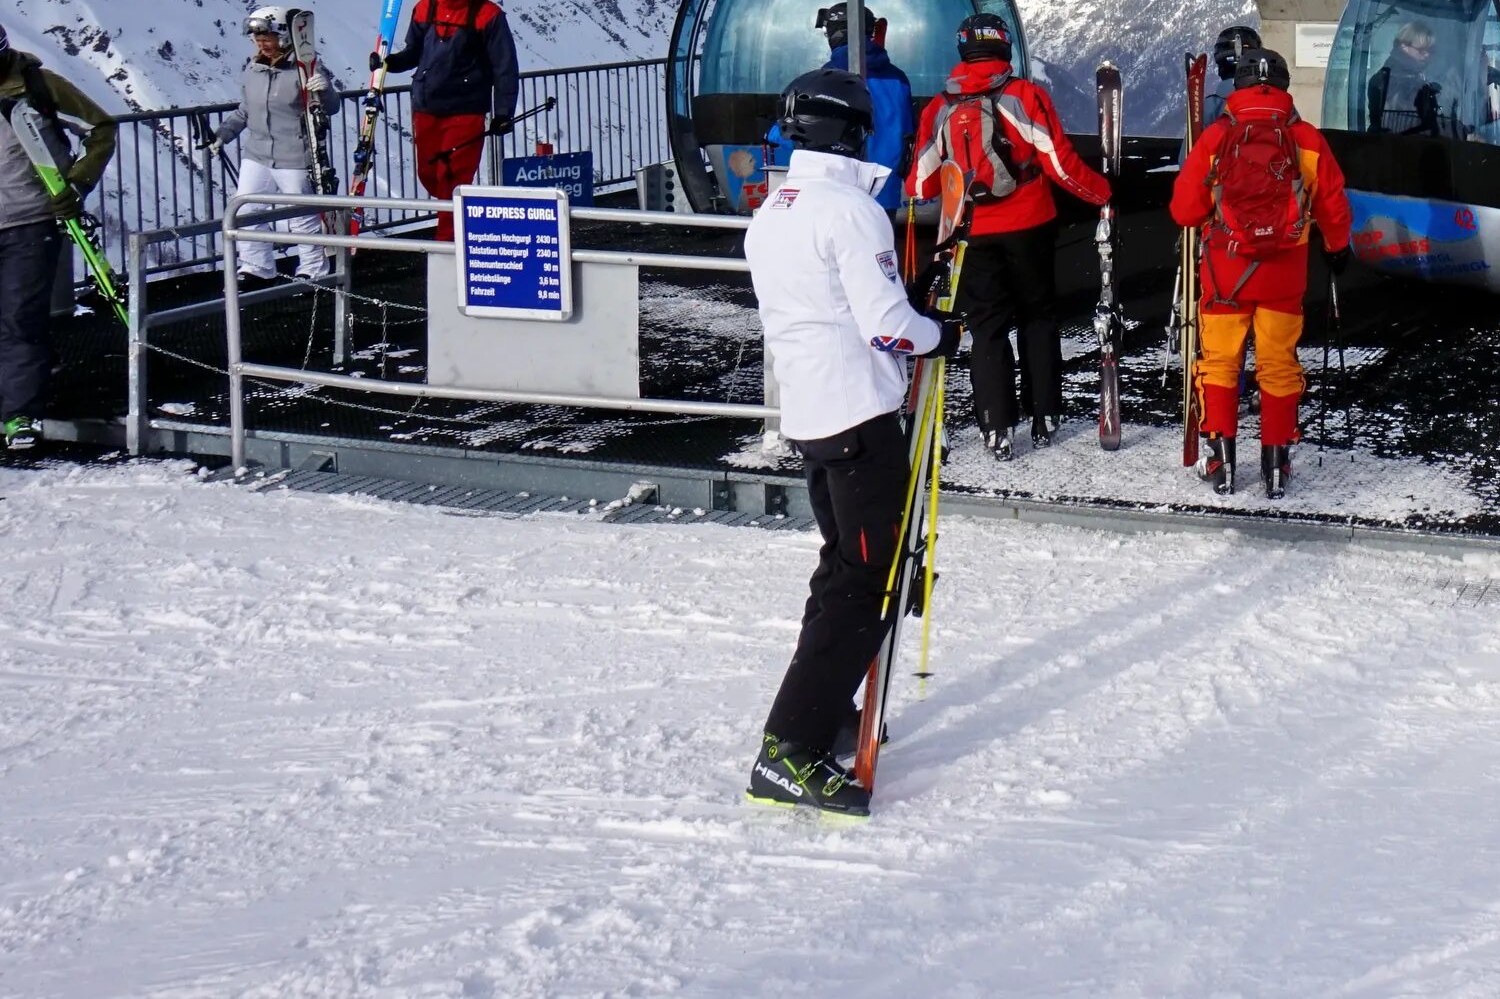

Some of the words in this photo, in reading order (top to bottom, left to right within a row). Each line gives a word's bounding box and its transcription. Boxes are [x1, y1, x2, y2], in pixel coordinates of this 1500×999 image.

[515, 165, 581, 183] Achtung
[467, 205, 484, 218] TOP
[486, 206, 526, 219] EXPRESS
[527, 208, 557, 221] GURGL
[1454, 209, 1476, 231] 42
[468, 232, 501, 244] Bergstation
[501, 233, 531, 245] Hochgurgl
[468, 245, 498, 256] Talstation
[499, 246, 529, 258] Obergurgl
[469, 259, 523, 271] Höhenunterschied
[543, 263, 552, 272] 90
[470, 273, 511, 285] Betriebslänge
[549, 277, 559, 286] km
[470, 286, 495, 296] Fahrzeit
[549, 290, 560, 300] min
[754, 762, 804, 798] HEAD
